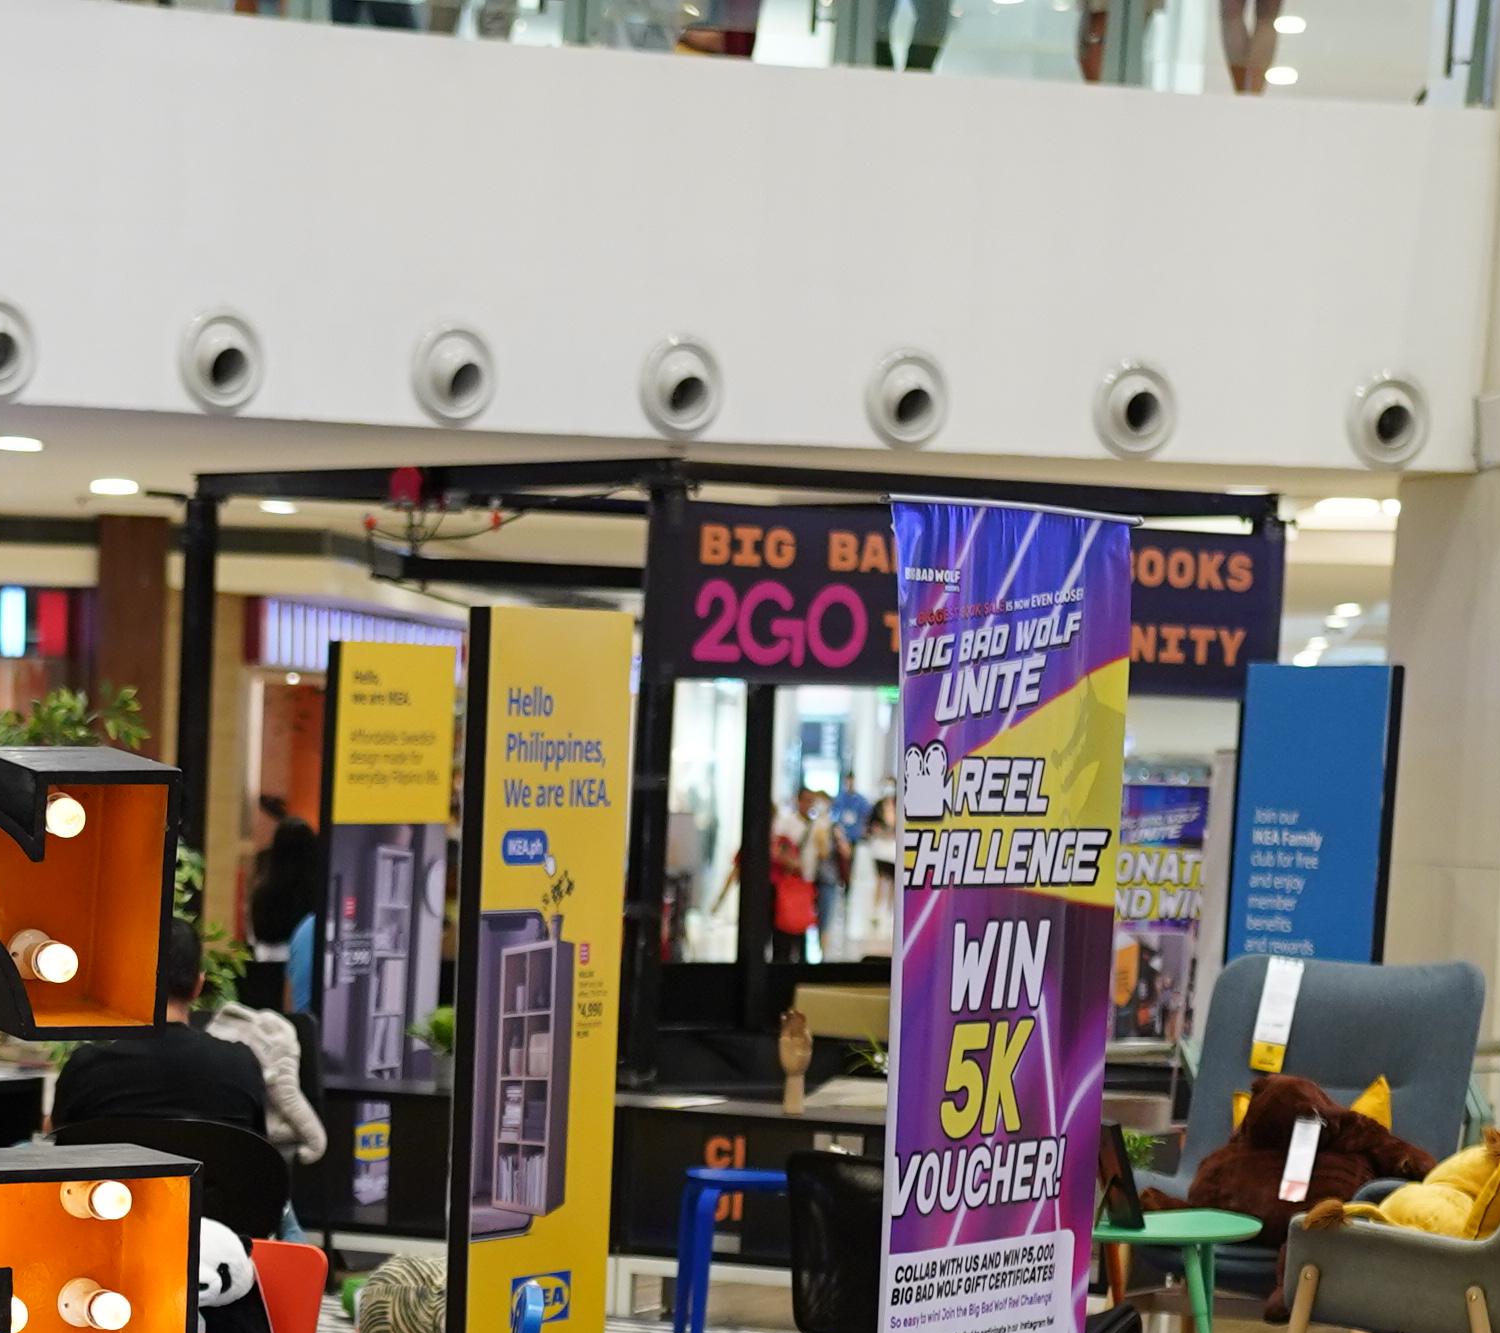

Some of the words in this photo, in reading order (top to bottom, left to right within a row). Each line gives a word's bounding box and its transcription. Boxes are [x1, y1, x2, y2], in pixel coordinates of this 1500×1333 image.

[700, 523, 796, 569] BIG
[829, 530, 894, 573] BA
[935, 569, 961, 583] WOLF
[1031, 592, 1053, 608] EVEN
[691, 580, 869, 667] 2GO
[906, 634, 954, 676] BIG
[958, 624, 1010, 666] BAD
[1015, 611, 1082, 652] WOLF
[507, 687, 553, 718] Hello
[934, 652, 1047, 726] UNITE
[506, 732, 607, 772] Philippines,
[504, 778, 530, 808] We
[535, 784, 565, 808] are
[569, 778, 612, 808] IKEA.
[954, 757, 1049, 816] REEL
[507, 838, 544, 860] IKEA.ph
[1252, 829, 1278, 845] IKEA
[1282, 830, 1323, 851] Family
[950, 919, 1052, 1013] WIN
[939, 1017, 1036, 1140] 5K
[892, 1134, 1067, 1217] VOUCHER!
[895, 1261, 937, 1284] COLLAB
[939, 1256, 963, 1277] WITH
[965, 1254, 978, 1271] US
[981, 1252, 1001, 1269] AND
[1003, 1248, 1020, 1266] WIN
[891, 1286, 913, 1306] BIG
[915, 1283, 935, 1302] BAD
[937, 1279, 962, 1298] WOLF
[964, 1274, 987, 1294] GIFT
[890, 1316, 901, 1329] So
[903, 1315, 919, 1329] easy
[921, 1315, 926, 1324] to
[942, 1308, 956, 1321] Join
[957, 1306, 967, 1318] the
[969, 1303, 979, 1318] Big
[982, 1301, 993, 1314] Bad
